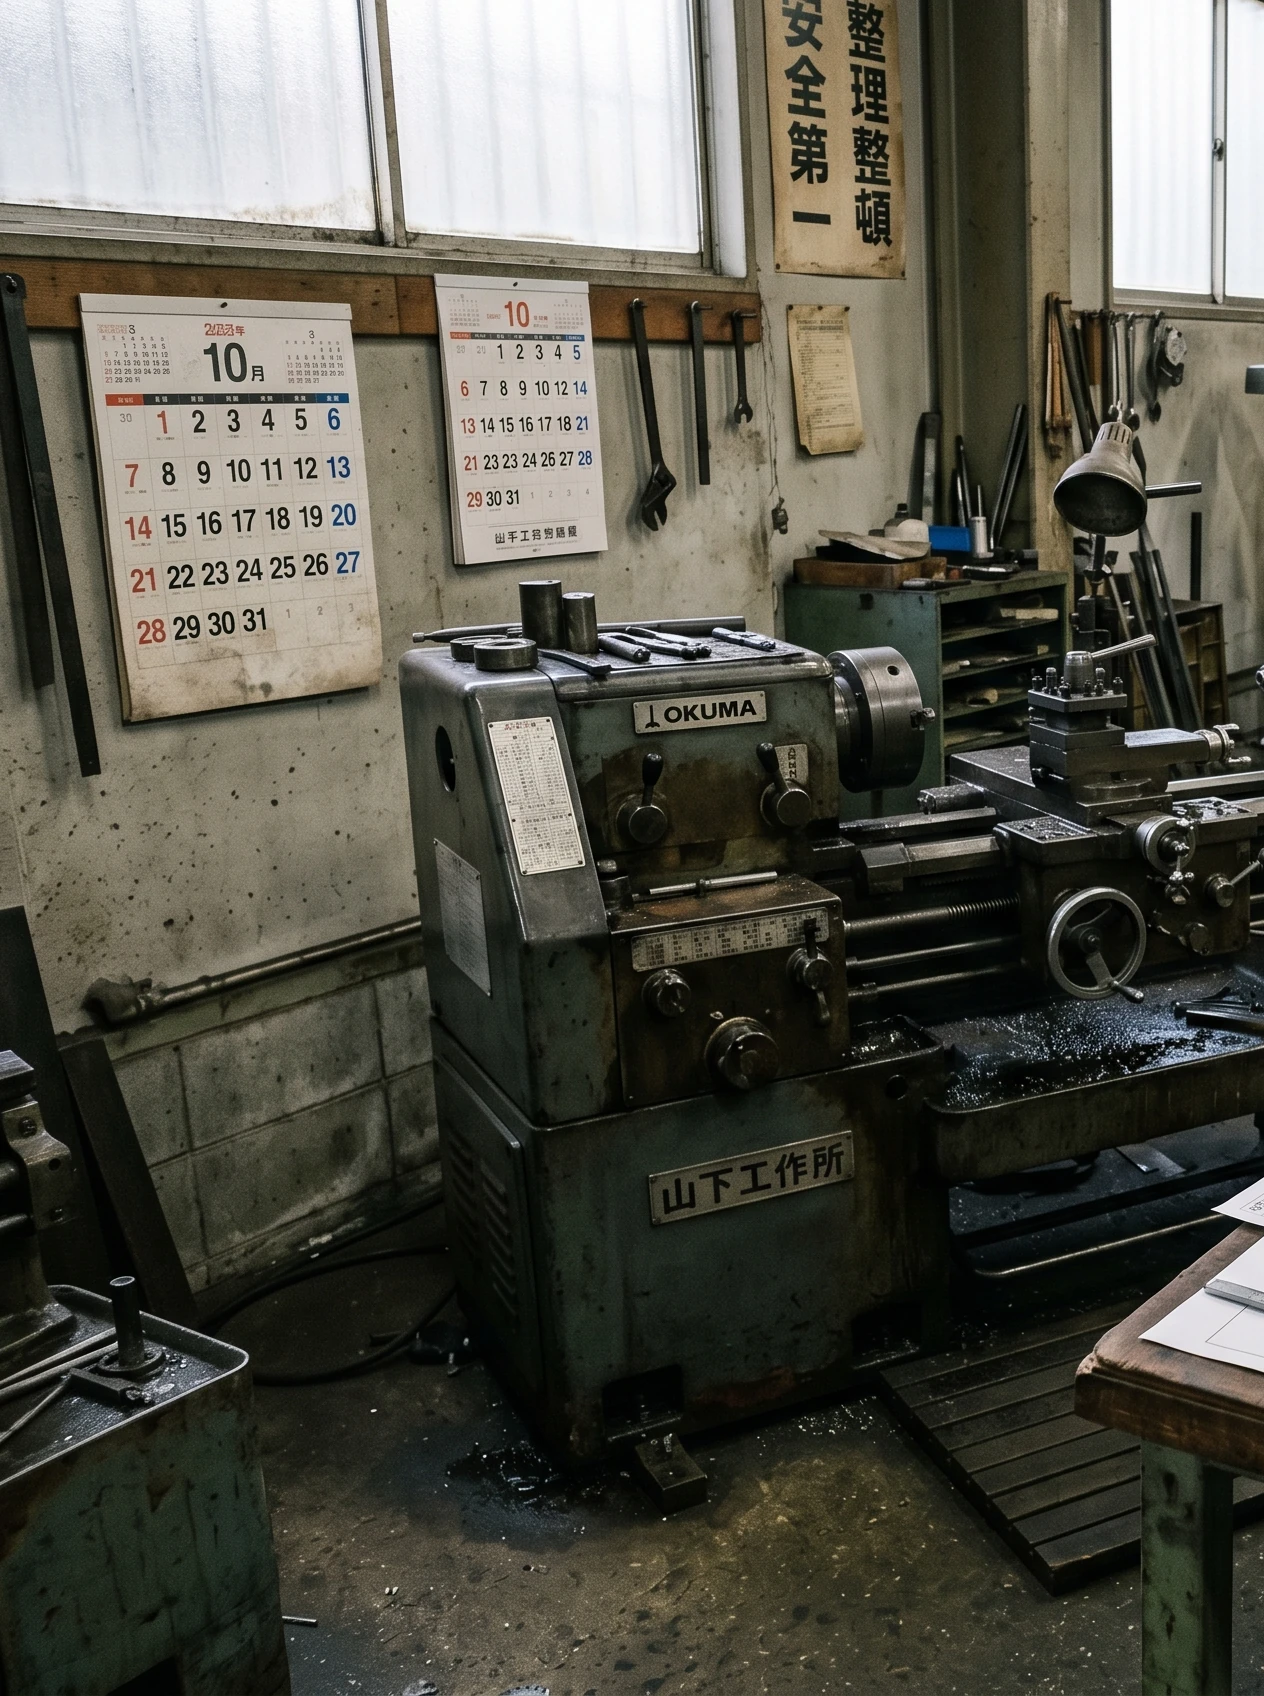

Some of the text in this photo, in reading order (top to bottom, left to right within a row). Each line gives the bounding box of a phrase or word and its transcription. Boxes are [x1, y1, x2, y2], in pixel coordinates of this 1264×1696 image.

[781, 0, 832, 226] 安全第一
[846, 0, 893, 248] 整理整頓
[504, 301, 530, 328] 10
[497, 344, 503, 359] 1
[516, 344, 524, 359] 2
[536, 344, 543, 360] 3
[555, 345, 562, 360] 4
[573, 345, 580, 360] 5
[461, 381, 587, 396] 6 7 8 9 10 12 14
[119, 408, 340, 434] 30 1 2 3 4 5 6
[461, 416, 588, 434] 13 14 15 16 17 18 21
[125, 456, 350, 487] 7 8 9 10 11 12 13
[464, 450, 592, 471] 21 23 23 24 26 27 28
[467, 492, 482, 507] 29
[486, 490, 501, 506] 30
[506, 490, 519, 505] 31
[125, 504, 356, 540] 14 15 16 17 18 19 20
[130, 551, 360, 593] 21 22 23 24 25 26 27
[137, 619, 166, 644] 28
[173, 615, 200, 640] 29
[208, 611, 235, 636] 30
[242, 608, 266, 632] 31
[664, 700, 757, 723] OKUMA
[662, 1142, 845, 1215] 山下工作所
